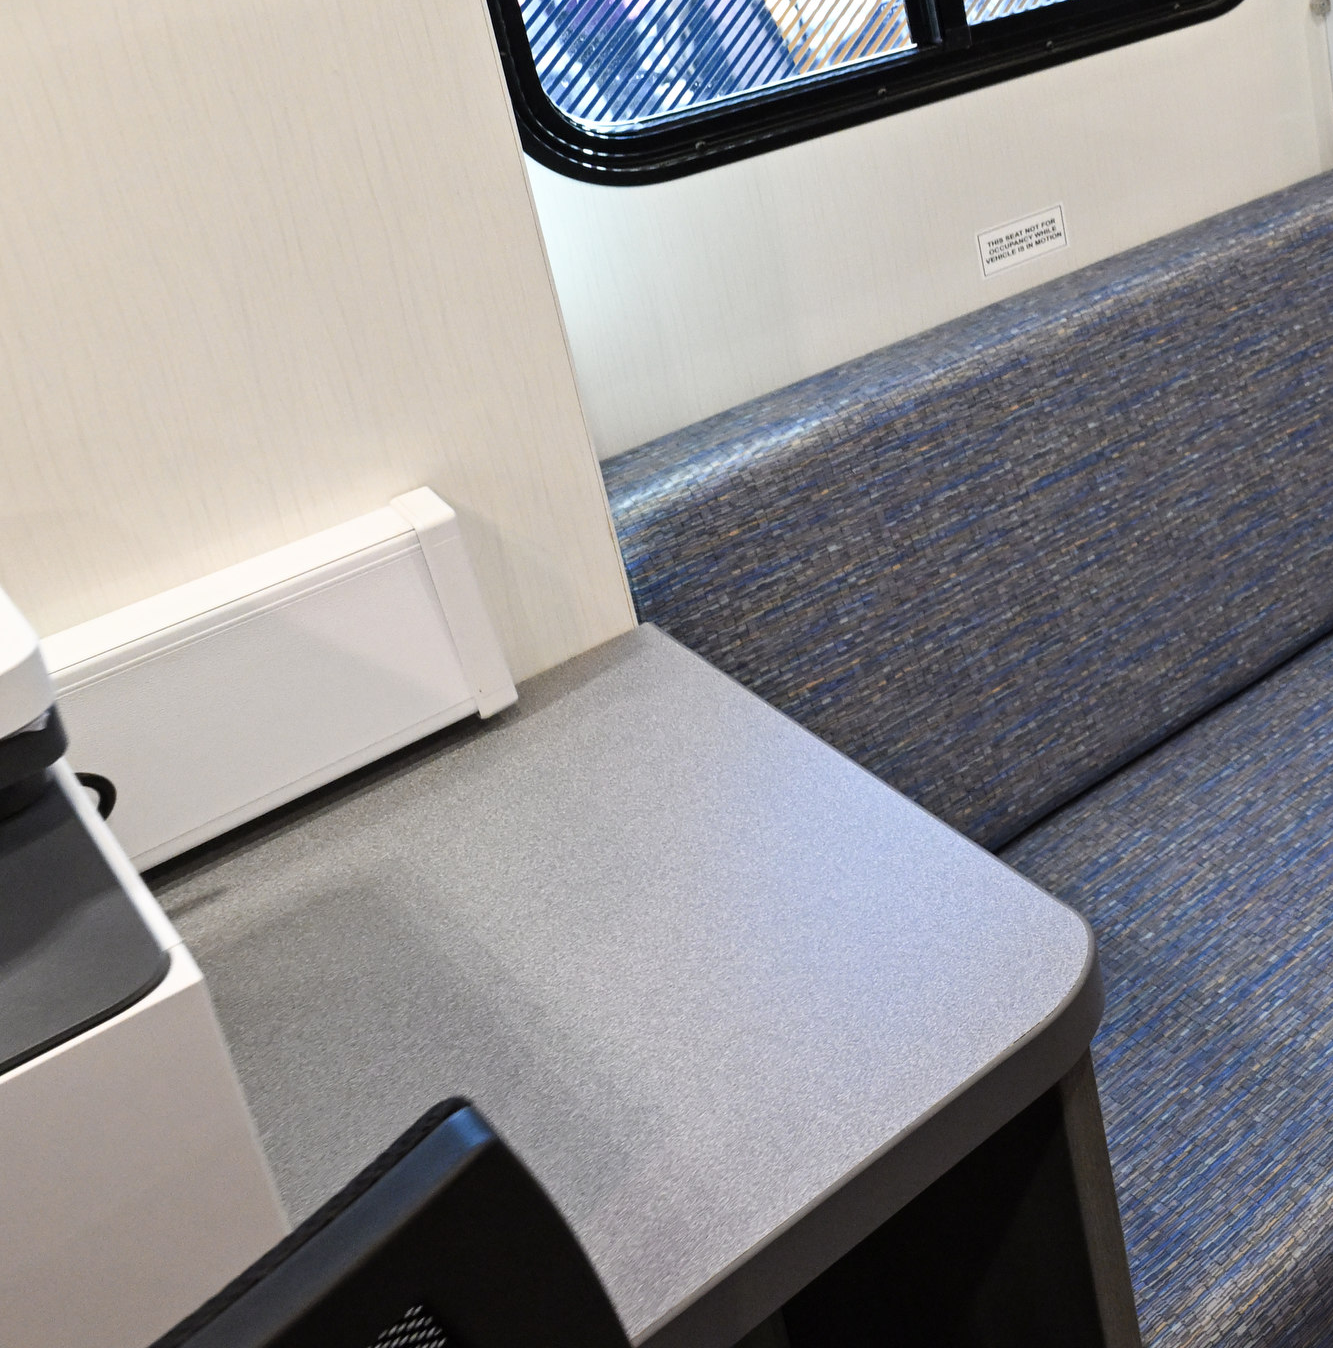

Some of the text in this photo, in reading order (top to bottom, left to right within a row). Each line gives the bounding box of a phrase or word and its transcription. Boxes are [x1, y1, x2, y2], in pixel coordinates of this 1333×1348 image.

[985, 249, 1017, 265] VEHICLE
[1034, 231, 1062, 246] MOTION
[987, 218, 1056, 248] THIS SEAT NOT FOR
[988, 226, 1057, 255] OCCUPANCY WHILE
